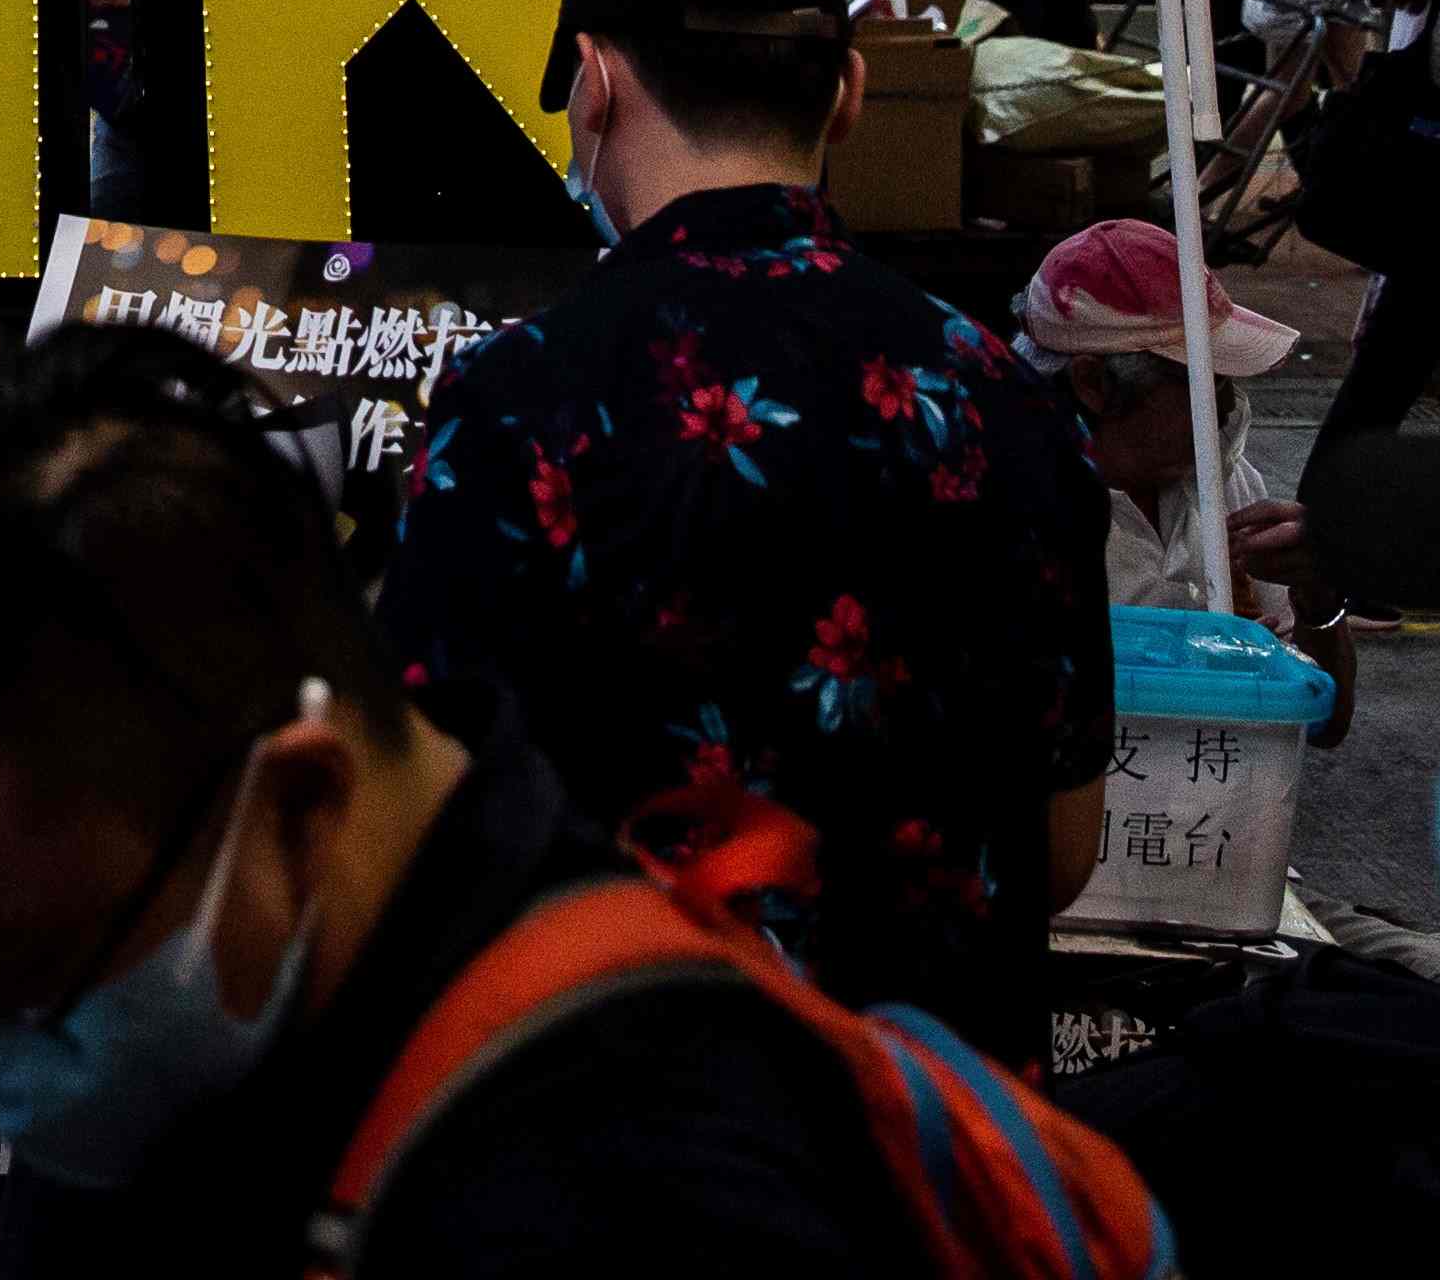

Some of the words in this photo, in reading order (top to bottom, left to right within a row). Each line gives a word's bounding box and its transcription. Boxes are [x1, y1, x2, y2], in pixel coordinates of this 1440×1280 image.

[94, 285, 524, 406] 用燭光點燃抗
